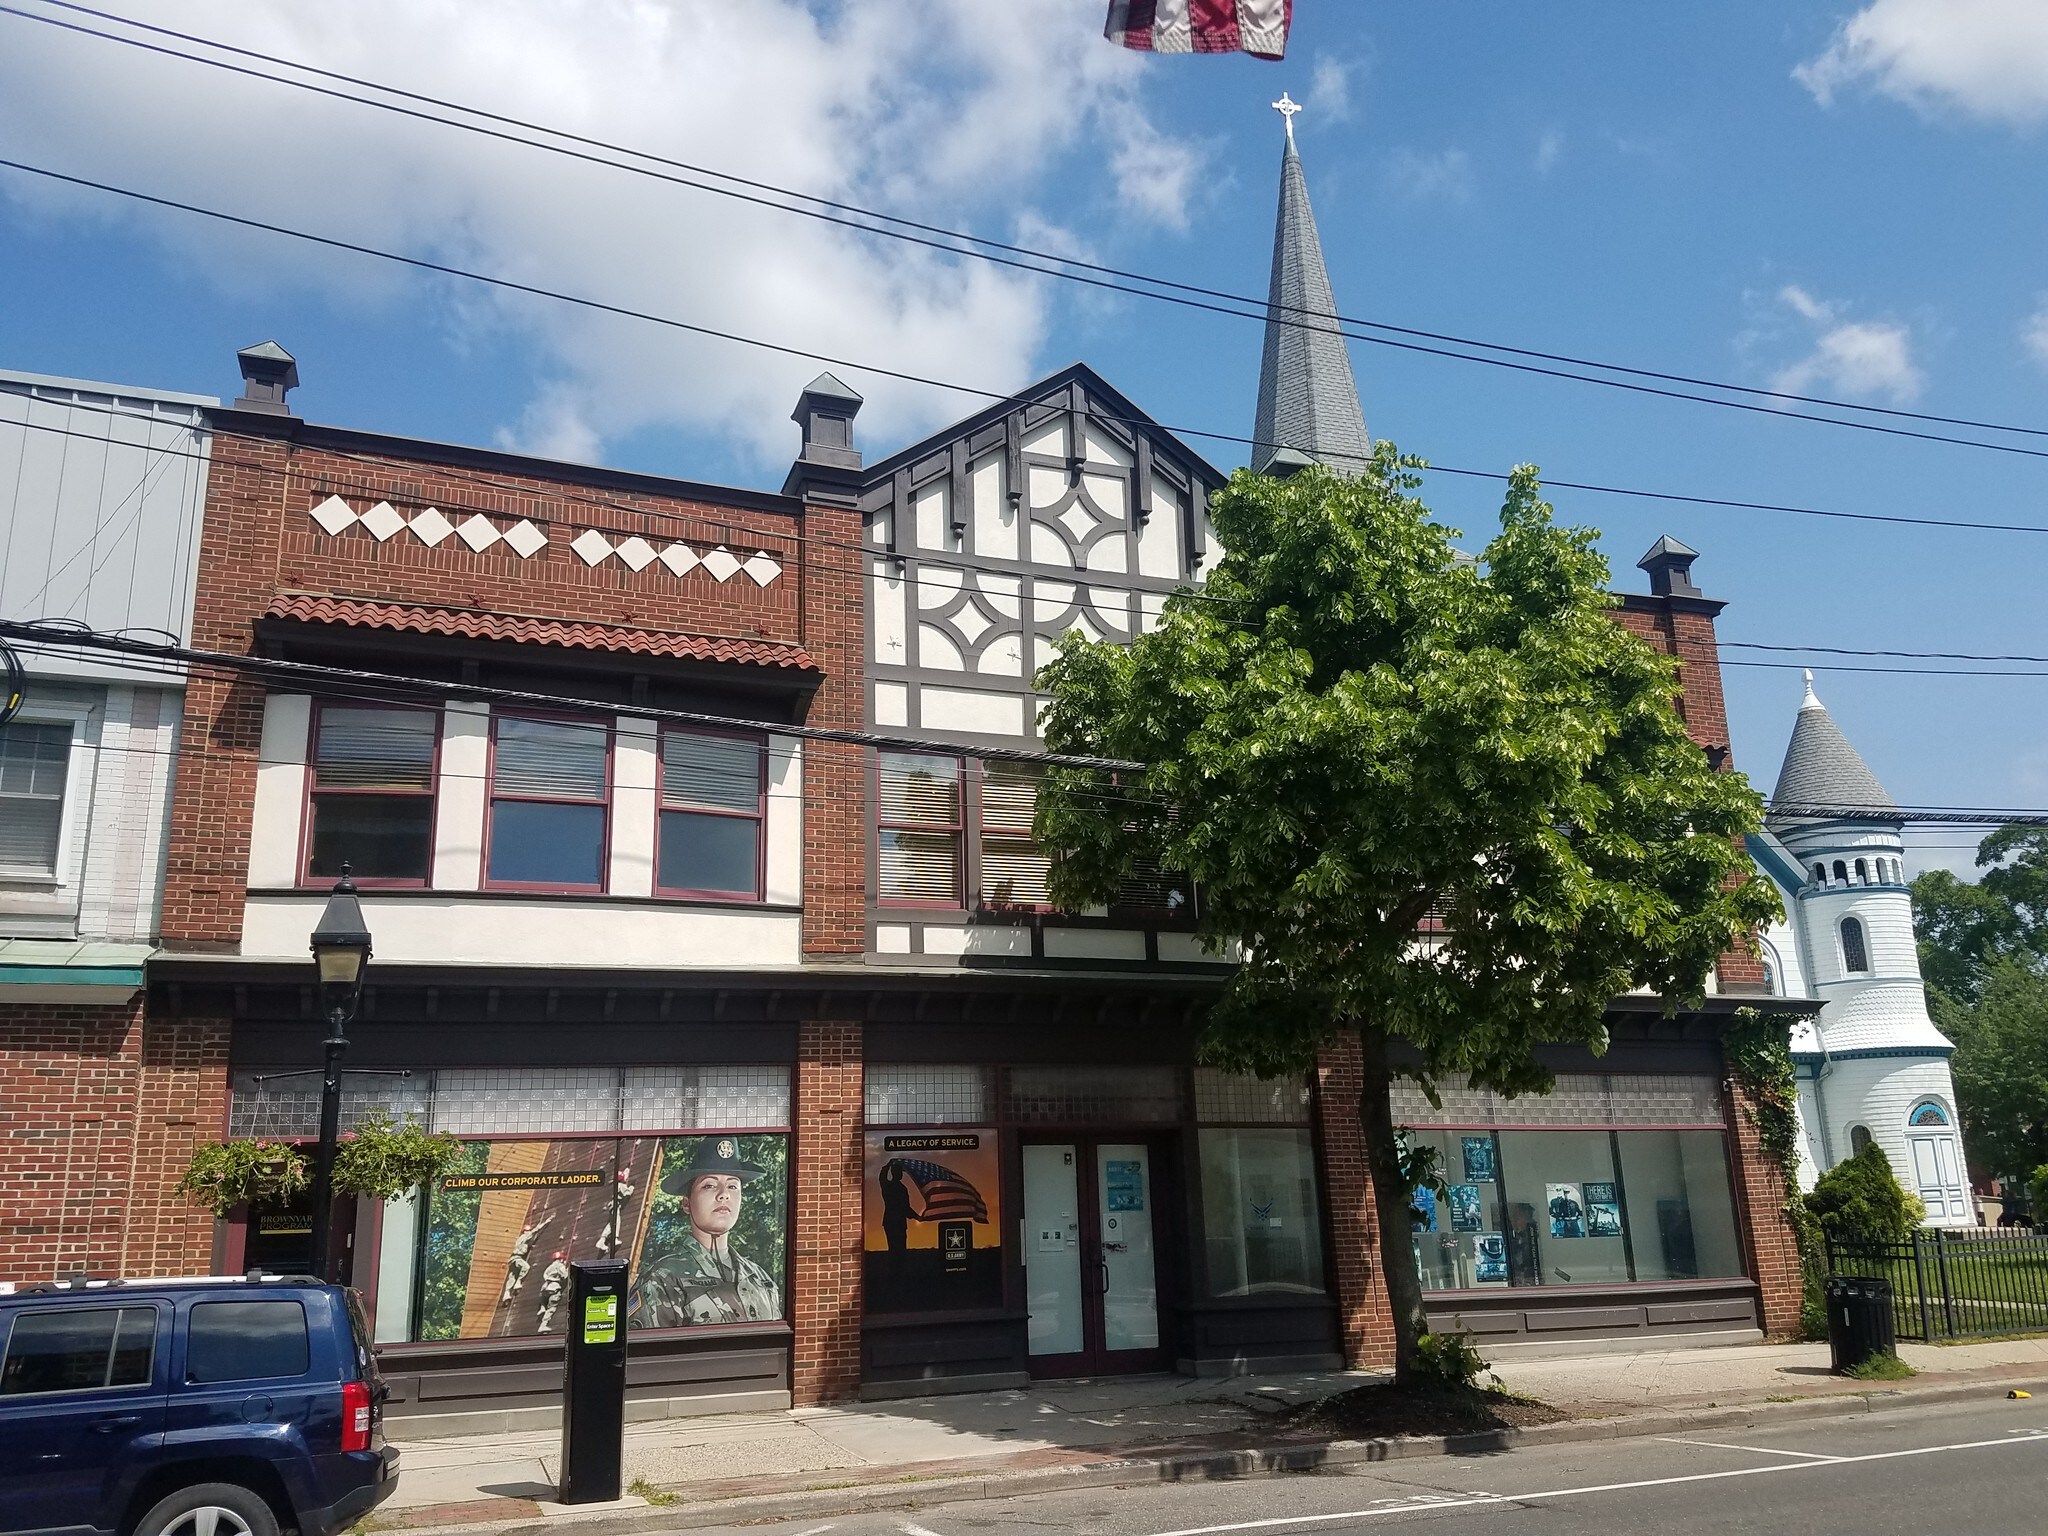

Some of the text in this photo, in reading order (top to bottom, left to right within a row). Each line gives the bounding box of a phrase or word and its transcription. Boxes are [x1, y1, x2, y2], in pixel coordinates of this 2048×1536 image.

[896, 1139, 928, 1147] LEGACY
[929, 1139, 940, 1147] OF
[941, 1138, 976, 1146] SERVICE.
[445, 1174, 601, 1187] CLIMB OUR CORPORATE LADDER.
[1586, 1185, 1613, 1195] THERE IS
